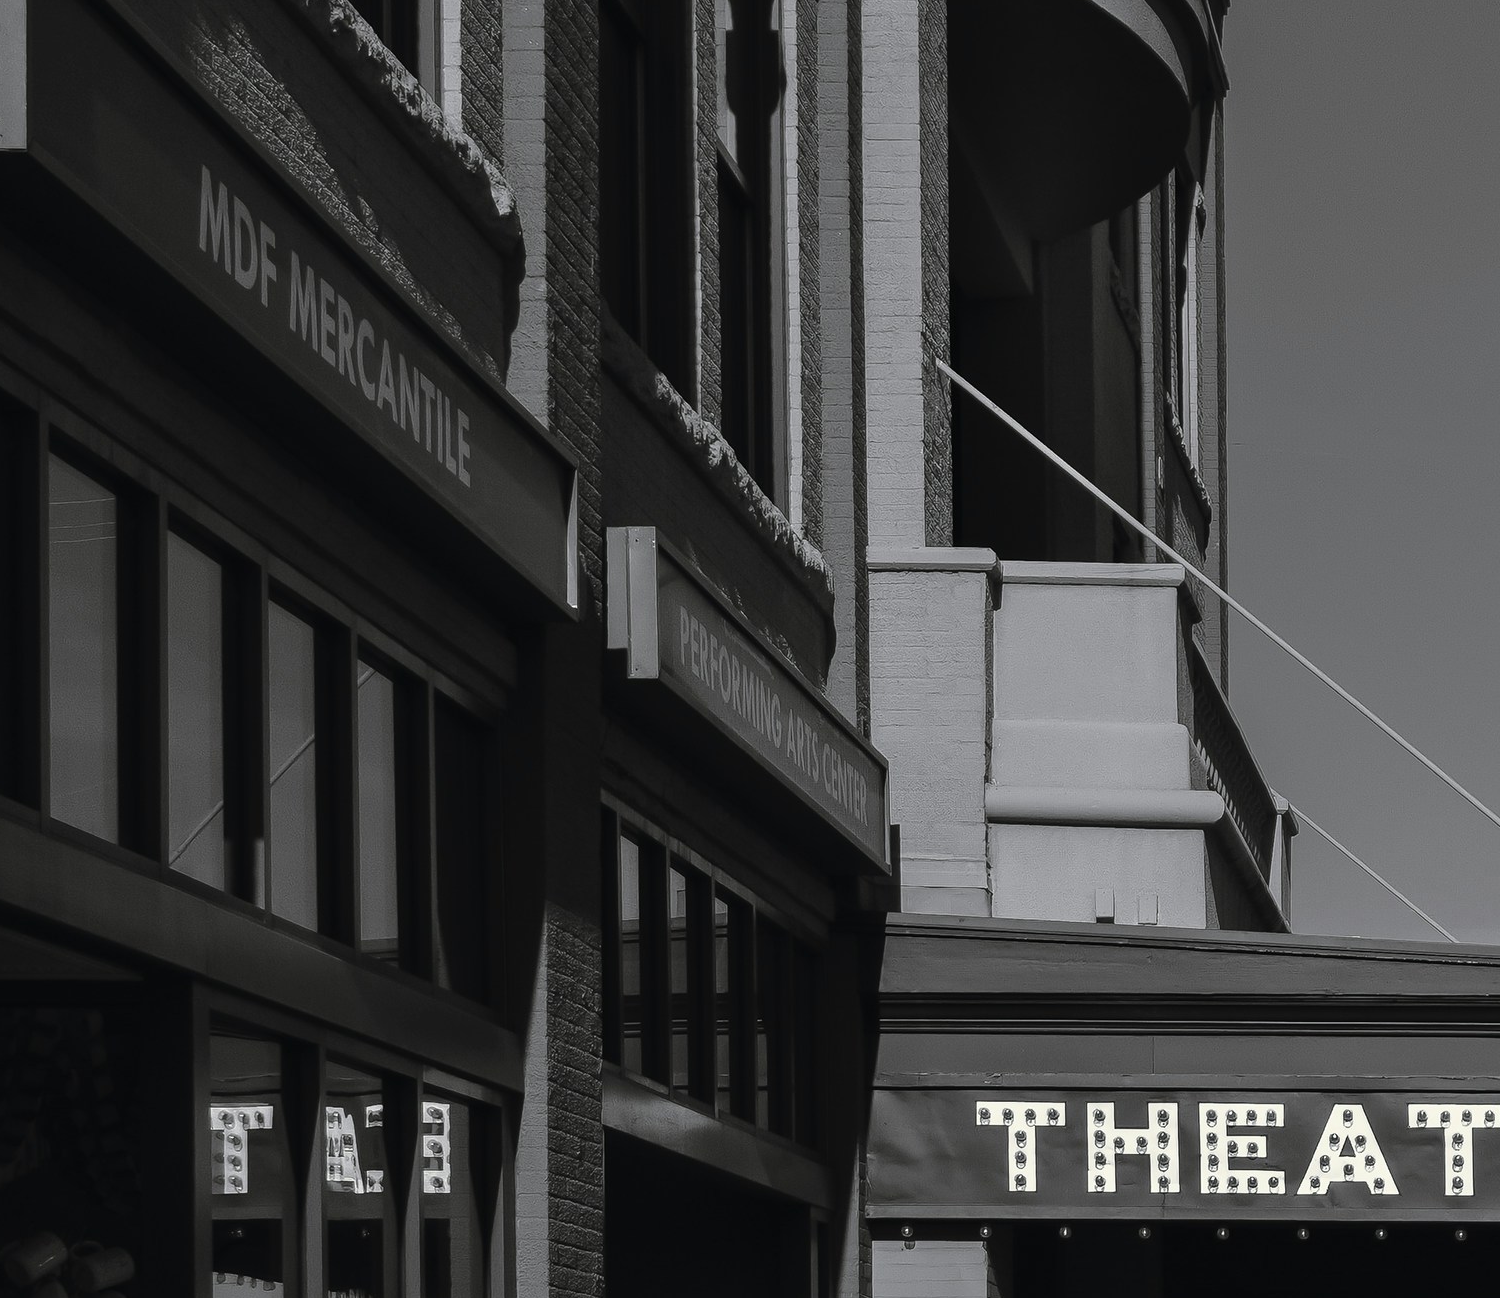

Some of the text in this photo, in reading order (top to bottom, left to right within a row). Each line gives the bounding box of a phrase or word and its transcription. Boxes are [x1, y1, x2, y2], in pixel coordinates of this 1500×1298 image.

[199, 165, 472, 489] MDF MERCANTILE
[679, 605, 869, 827] PERFORMING ARTS CENTER
